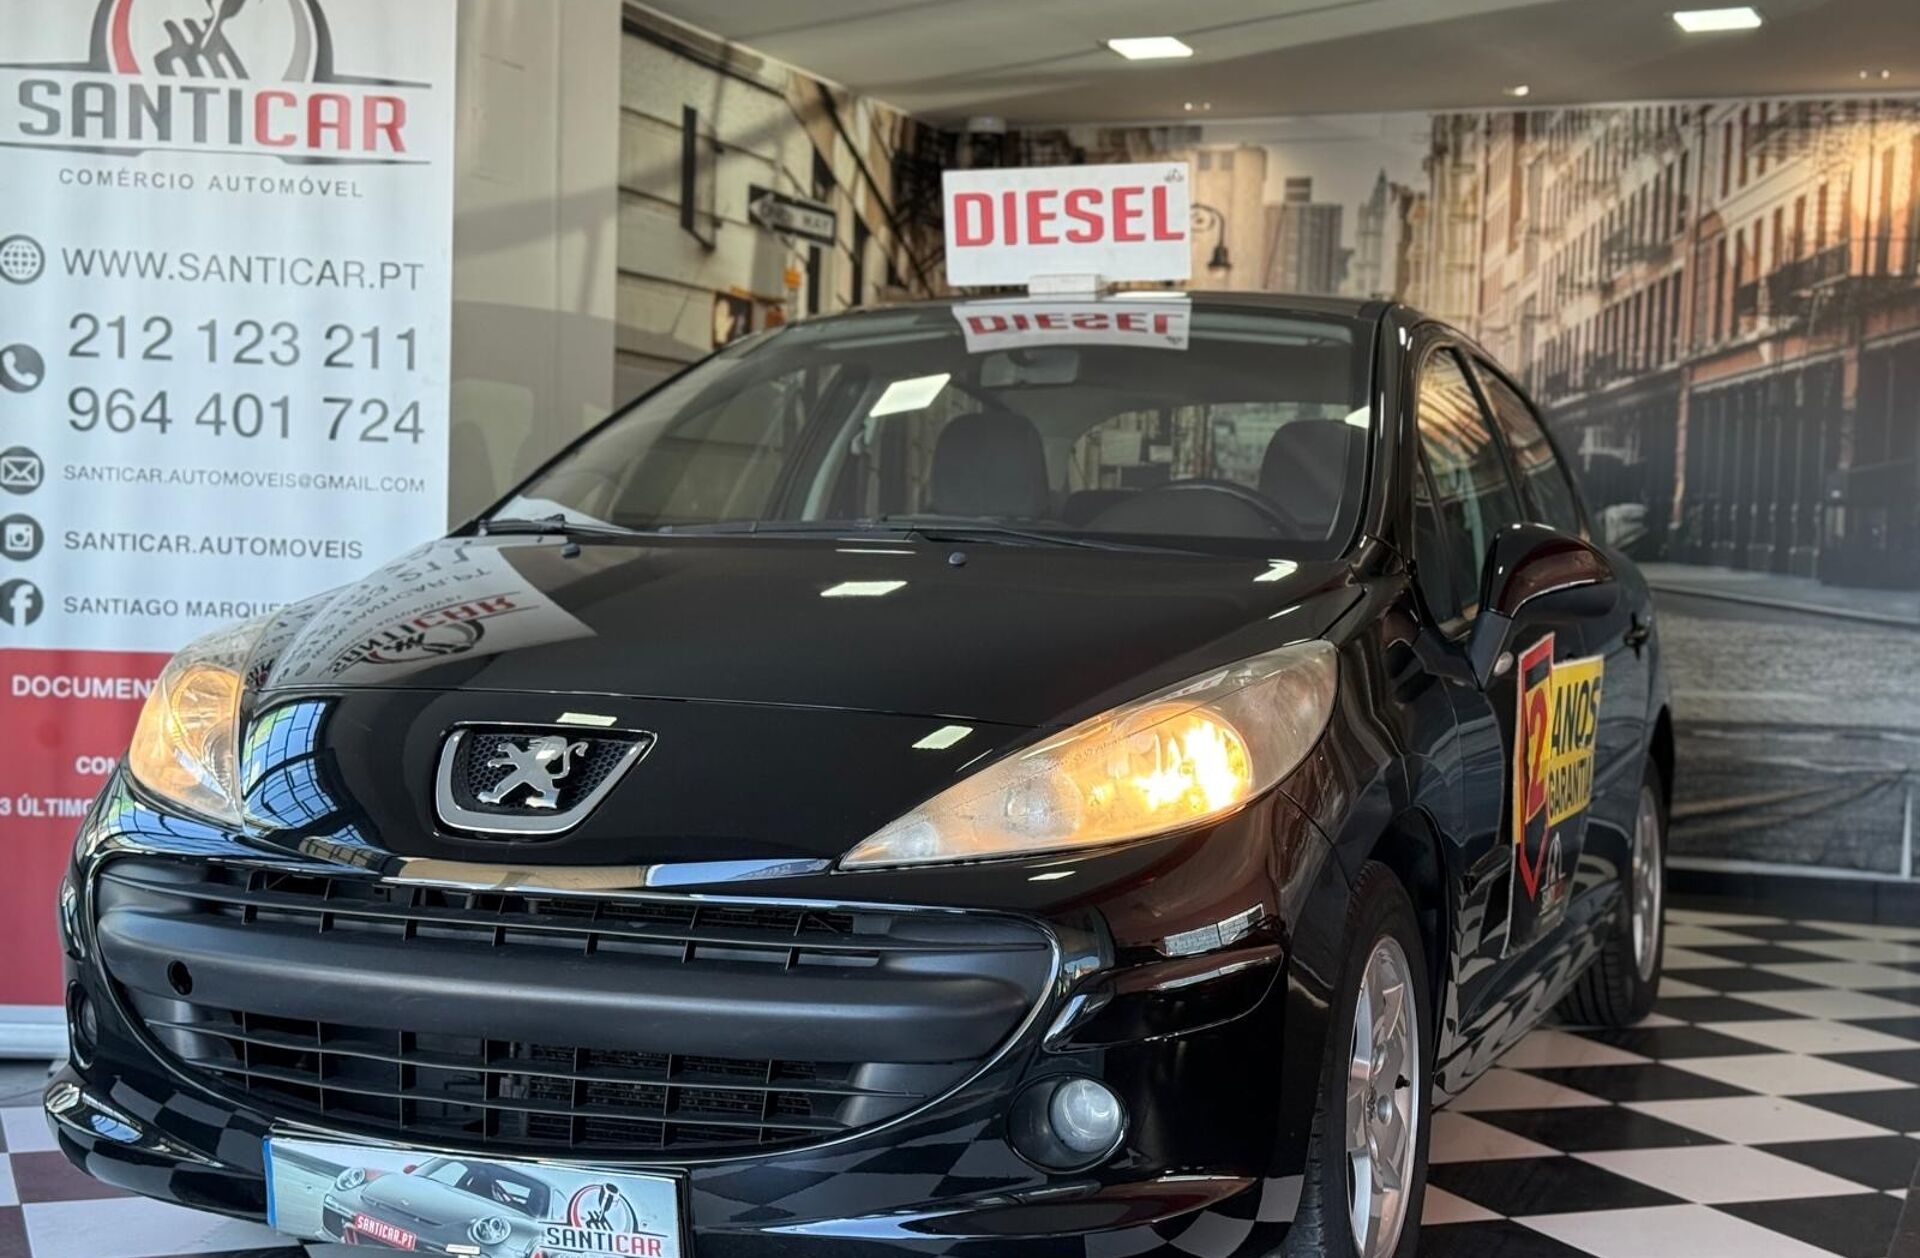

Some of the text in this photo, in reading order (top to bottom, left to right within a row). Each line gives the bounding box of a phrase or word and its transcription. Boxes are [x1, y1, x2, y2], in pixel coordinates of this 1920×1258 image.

[17, 79, 407, 153] SANTICAR
[58, 167, 364, 198] COMÉRCIO AUTOMÓVEL
[953, 185, 1186, 247] DIESEL
[61, 248, 424, 291] WWW.SANTICAR.PT
[68, 313, 418, 371] 212 123 211
[68, 386, 425, 444] 964 401 724
[63, 465, 426, 493] SANTICAR.AUTOMOVEIS@GMAIL.COM
[64, 531, 363, 560] SANTICAR.AUTOMOVEIS
[63, 596, 291, 618] SANTIAGO MARQU
[12, 675, 157, 699] DOCUMEN
[1529, 676, 1601, 818] 2 ANOS
[0, 797, 12, 816] 3
[356, 1215, 414, 1248] SANTICAR.PT
[546, 1227, 662, 1257] SANTICAR
